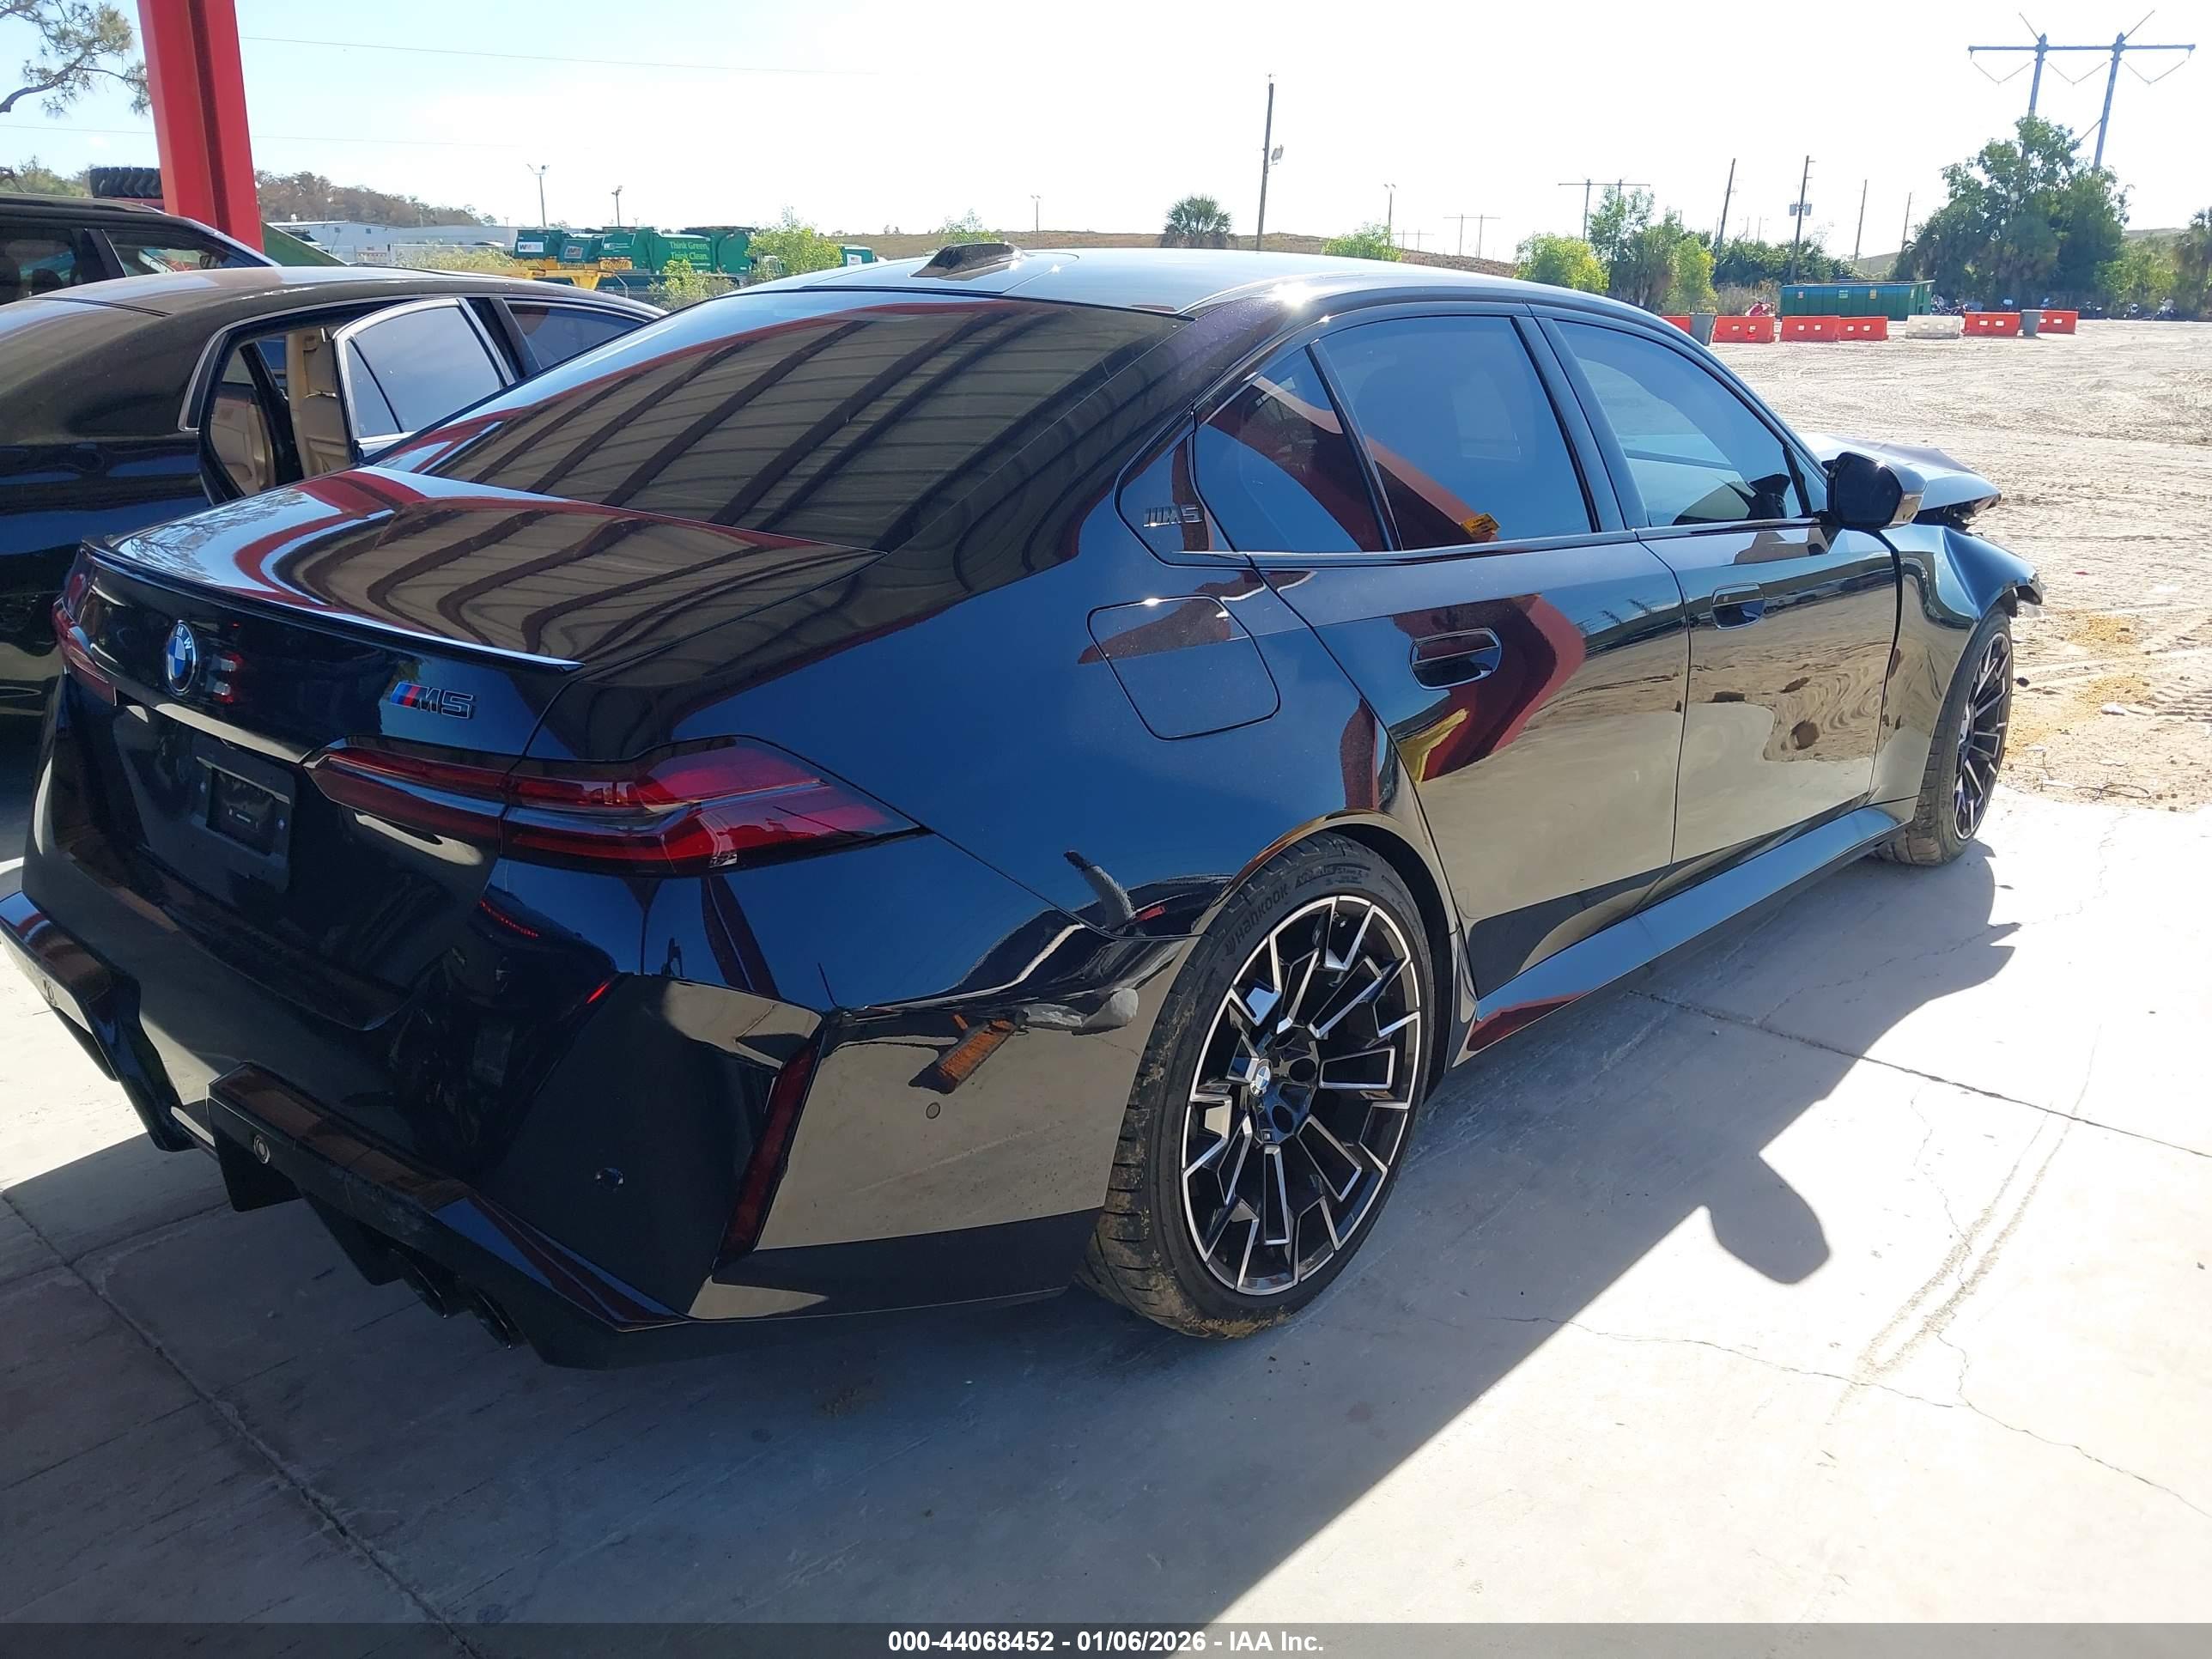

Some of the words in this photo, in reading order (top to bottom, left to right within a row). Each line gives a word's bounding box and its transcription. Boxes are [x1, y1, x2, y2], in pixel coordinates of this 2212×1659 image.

[688, 241, 709, 251] Green,
[690, 252, 708, 260] Clean.
[410, 684, 475, 720] M5
